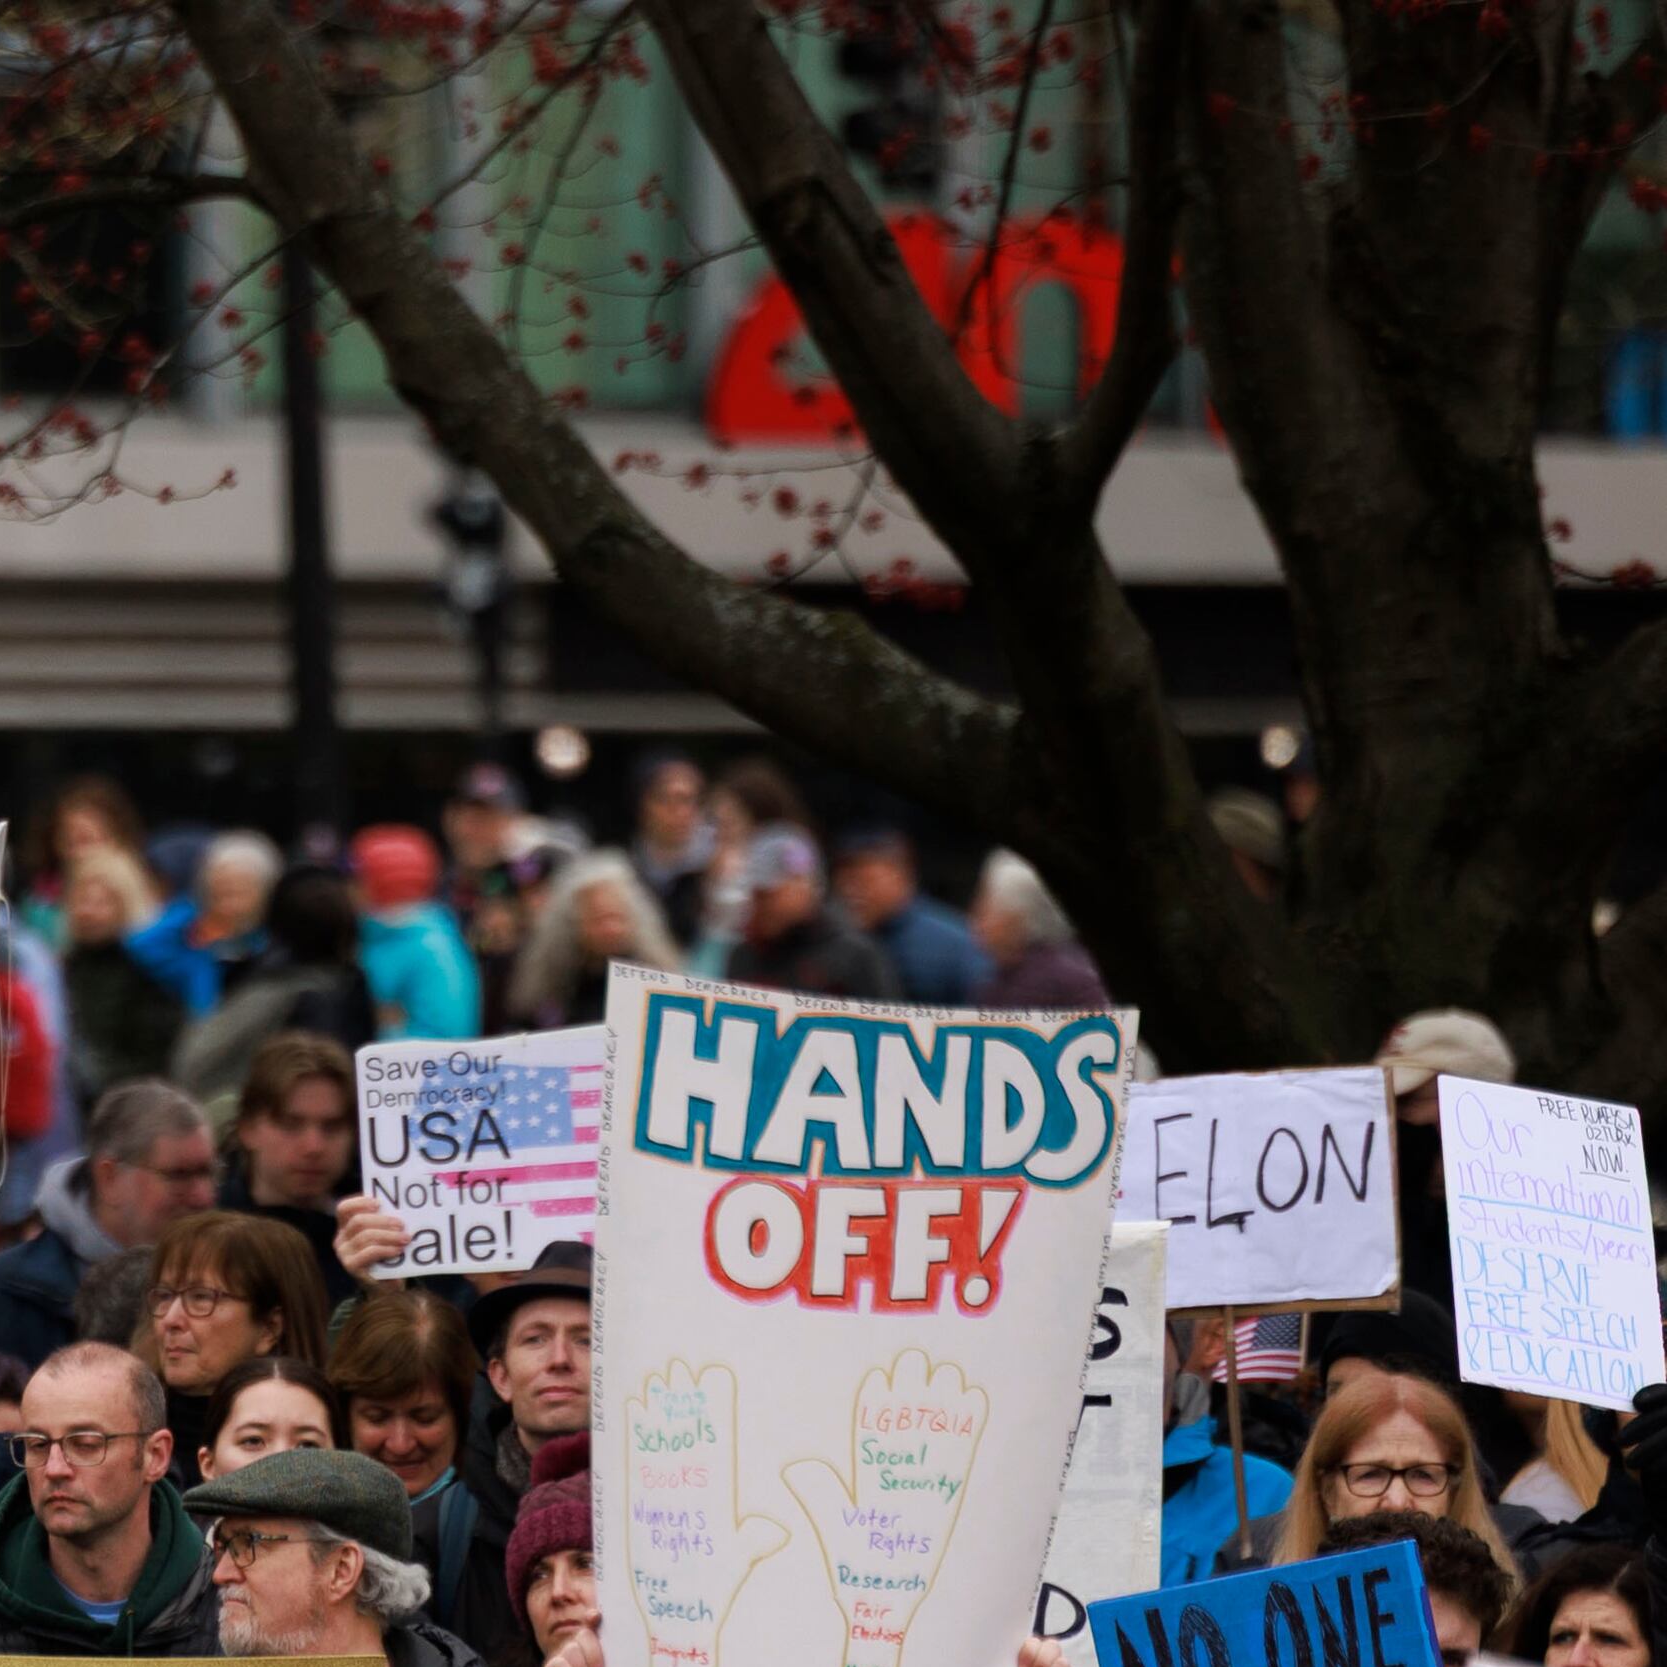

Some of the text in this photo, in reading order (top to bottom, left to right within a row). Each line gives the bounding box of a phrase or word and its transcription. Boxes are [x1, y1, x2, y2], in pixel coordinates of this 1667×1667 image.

[614, 965, 770, 1003] DEFEND DEMOCRACY
[794, 994, 955, 1023] DEFEND DEMOCRACY
[365, 1051, 503, 1082] Save Our
[634, 992, 1127, 1189] HANDS
[1455, 1091, 1532, 1158] Our
[1537, 1097, 1578, 1122] FREE
[369, 1109, 511, 1168] USA
[1154, 1112, 1375, 1233] ELON
[371, 1171, 511, 1210] Not for
[704, 1176, 1028, 1316] OFF!
[1457, 1237, 1601, 1308] DESERVE
[1464, 1289, 1637, 1350] FREE SPEECH
[1487, 1331, 1646, 1398] EDUCATION
[634, 1417, 716, 1452] Schools
[860, 1406, 973, 1436] LGBTQIA
[861, 1438, 928, 1466] Social
[879, 1469, 962, 1505] Security
[843, 1507, 902, 1529] Voter
[651, 1529, 715, 1562] Rights
[869, 1532, 931, 1560] Rights
[635, 1570, 668, 1593] Free
[838, 1565, 926, 1592] Research
[648, 1595, 713, 1622] Speech
[853, 1602, 892, 1619] Fair
